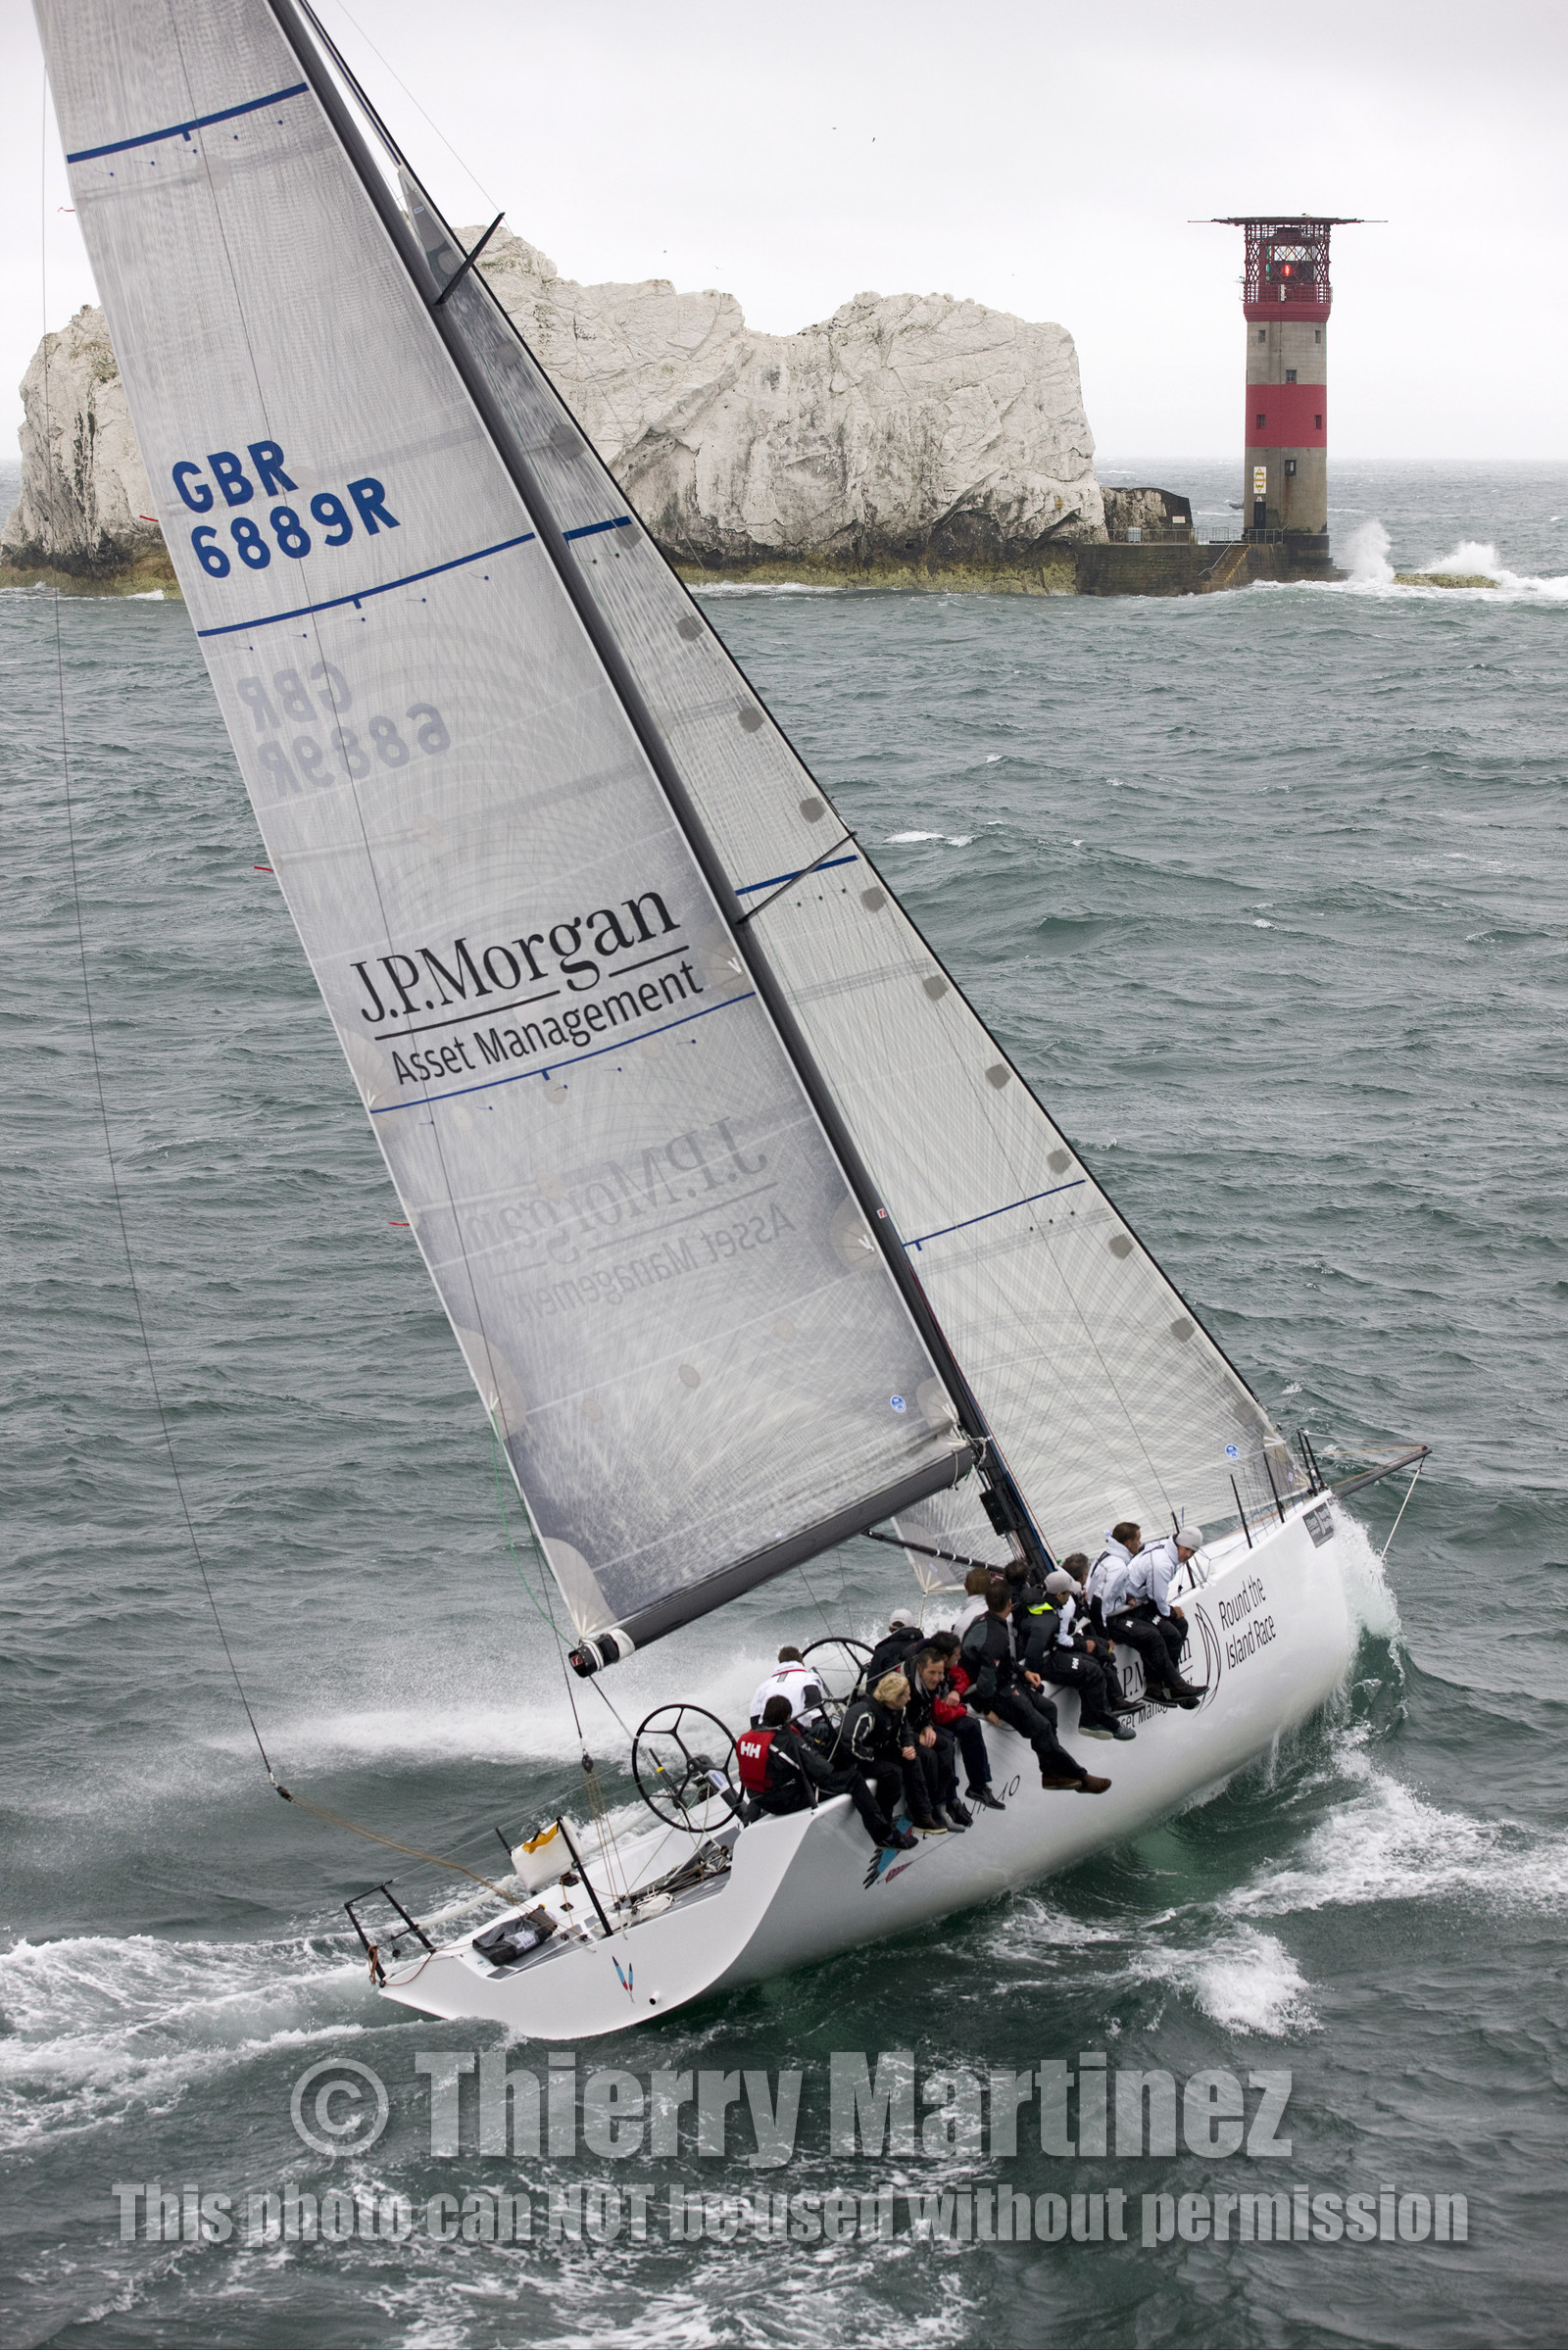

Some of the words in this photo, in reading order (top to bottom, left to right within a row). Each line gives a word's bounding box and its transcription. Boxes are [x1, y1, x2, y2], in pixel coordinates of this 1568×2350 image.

[172, 440, 299, 514] GBR
[191, 476, 401, 578] 6889R
[350, 890, 680, 1023] J.P.Morgan
[391, 1041, 477, 1086] Asset
[473, 958, 704, 1065] Management
[1218, 1580, 1251, 1632] Round
[1247, 1575, 1266, 1608] the
[1225, 1622, 1256, 1670] Island
[1252, 1615, 1277, 1649] Race
[740, 1740, 761, 1759] HH
